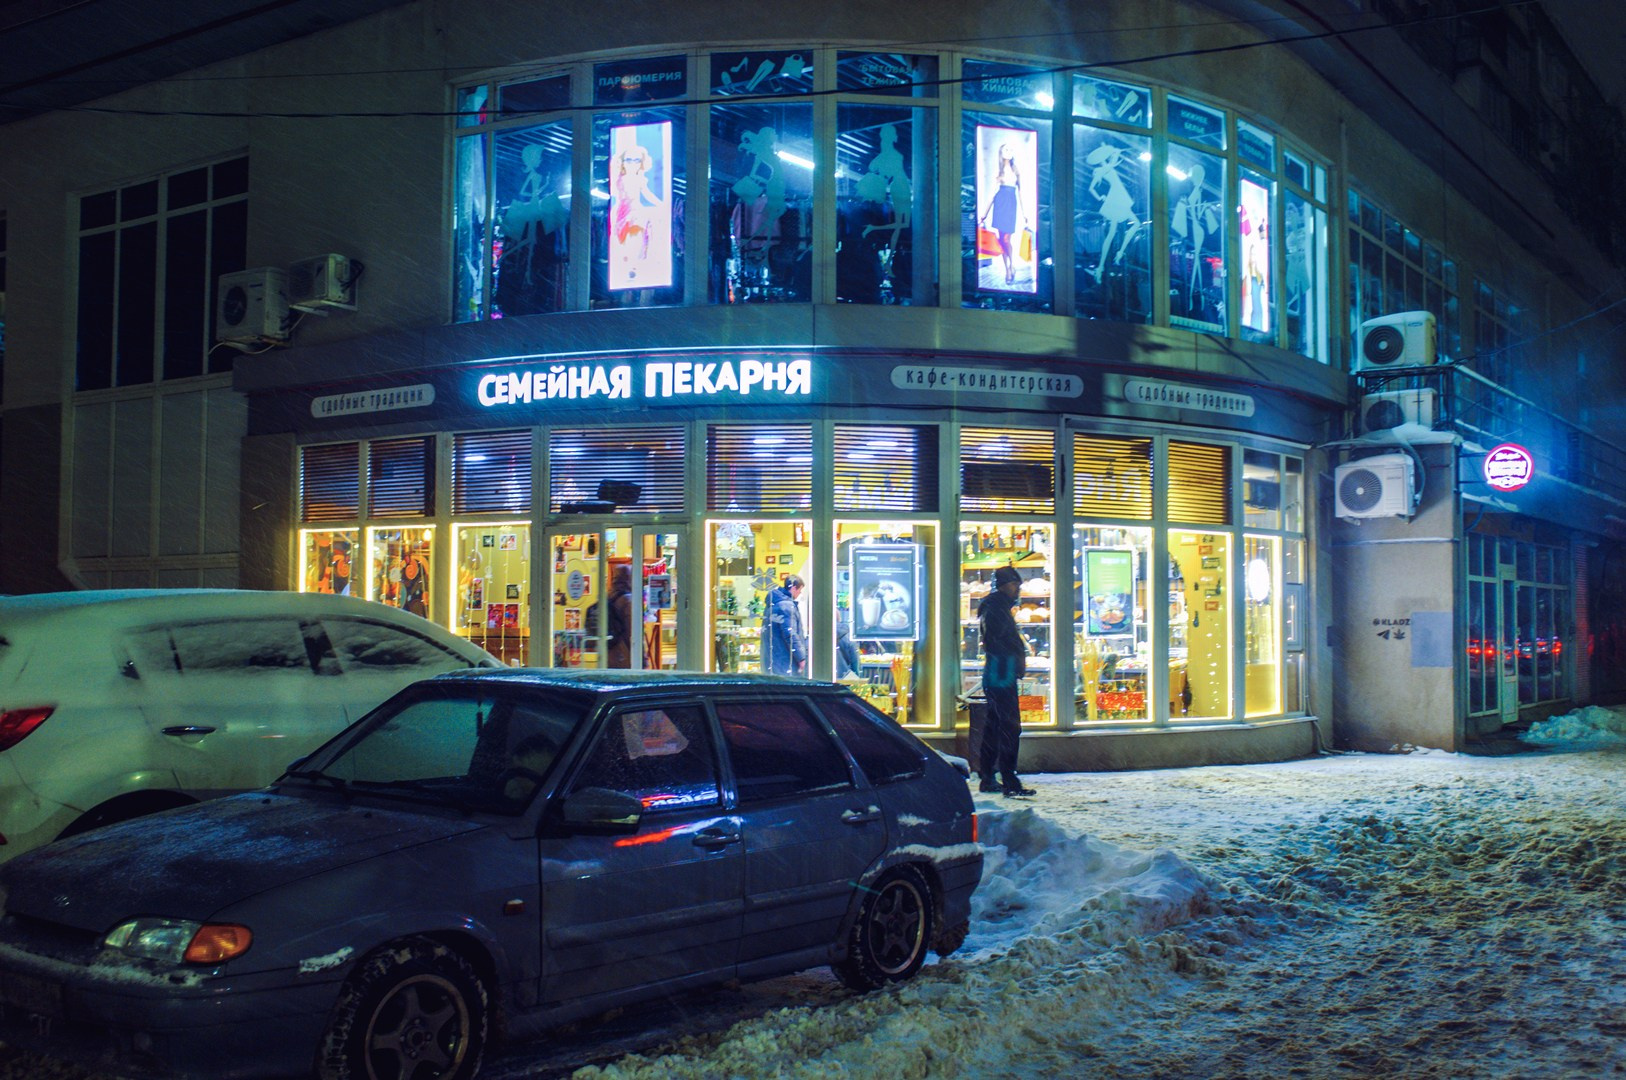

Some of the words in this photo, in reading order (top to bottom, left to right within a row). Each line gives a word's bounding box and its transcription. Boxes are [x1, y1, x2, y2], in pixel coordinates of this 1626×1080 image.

[599, 71, 682, 86] ПАРФЮМЕРИЯ
[982, 83, 1023, 96] ХИМИЯ
[477, 365, 632, 407] СЕМЕЙНАЯ
[644, 359, 812, 398] ПЕКАРНЯ
[906, 367, 1071, 393] кафе-кондитерская
[321, 395, 366, 415] сдобные
[370, 388, 423, 409] традиции
[1138, 385, 1191, 405] сдобные
[1196, 392, 1247, 412] традиции
